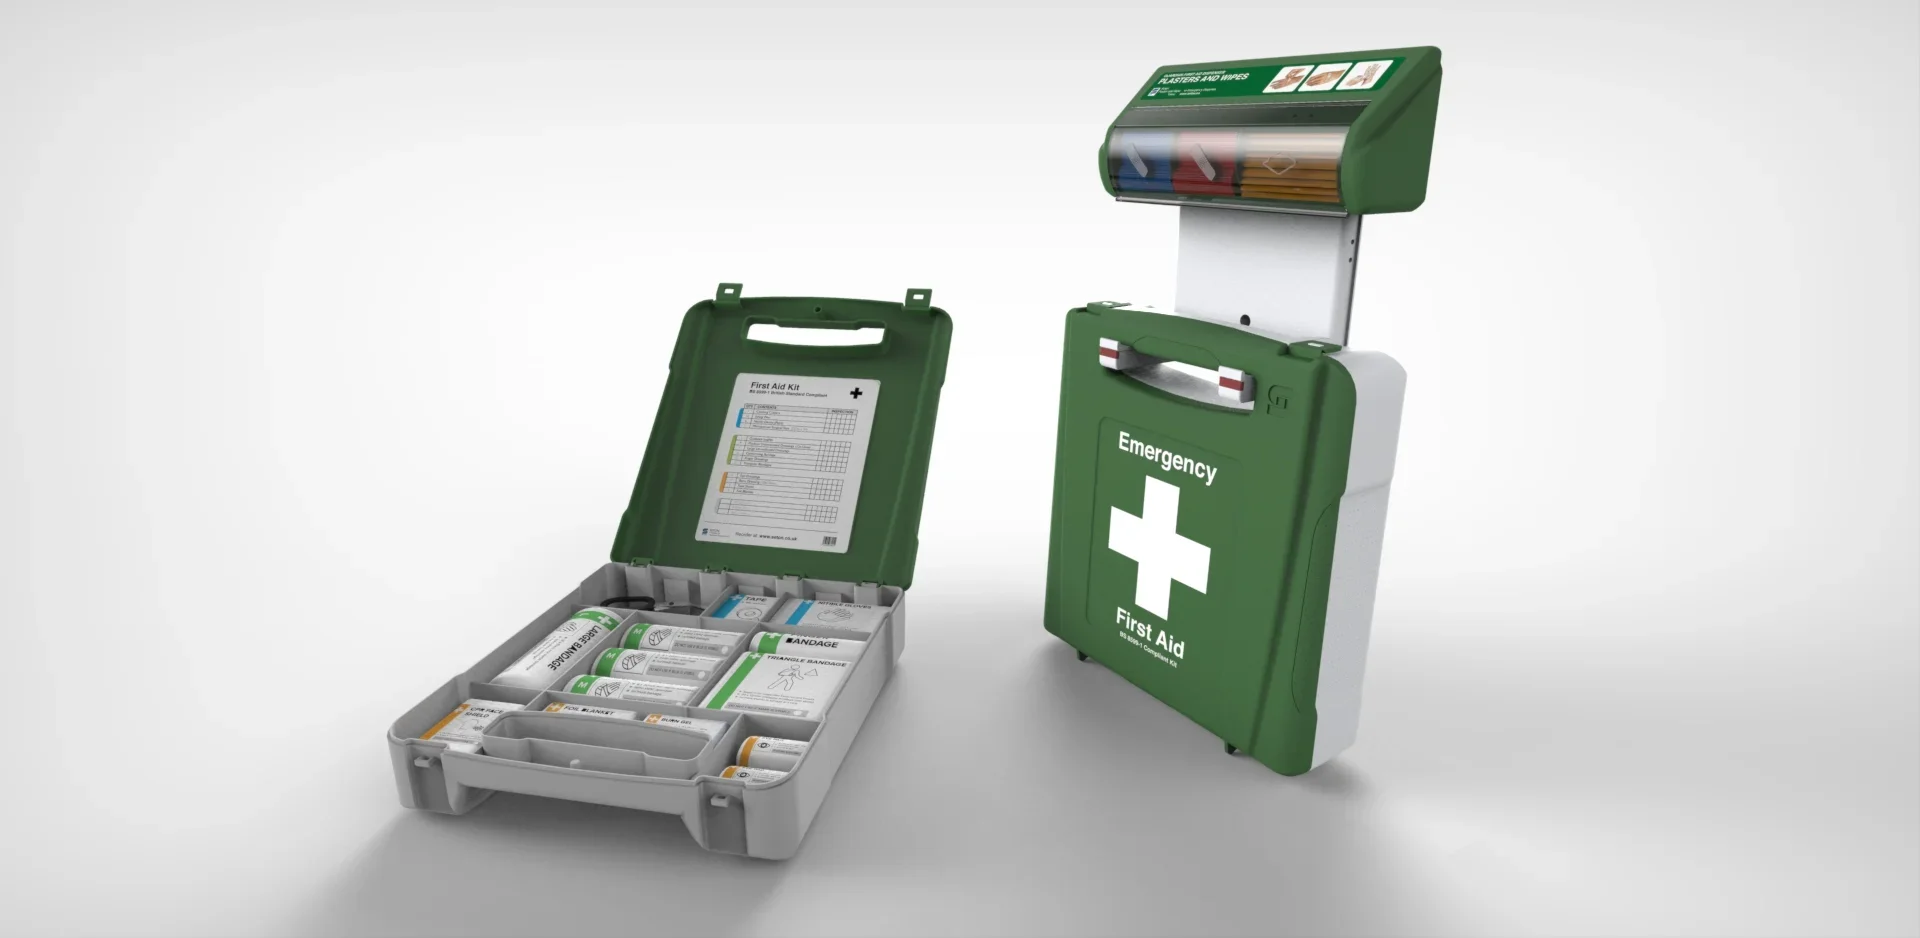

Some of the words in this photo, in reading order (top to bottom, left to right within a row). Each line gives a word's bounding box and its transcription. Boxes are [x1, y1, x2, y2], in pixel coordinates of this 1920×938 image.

[1158, 76, 1201, 84] PLASTERS
[1200, 74, 1220, 82] AND
[1220, 73, 1250, 81] WIPES
[750, 382, 770, 390] First
[771, 382, 786, 390] Aid
[787, 383, 800, 391] Kit
[1118, 431, 1217, 486] Emergency
[577, 625, 602, 645] LARGE
[1116, 606, 1152, 641] First
[1155, 630, 1185, 659] Aid
[547, 641, 583, 671] BANDAGE
[766, 655, 806, 664] TRIANGLE
[806, 659, 847, 668] BANDAGE
[1119, 630, 1127, 640] BS
[1143, 644, 1169, 663] Compliant
[1169, 658, 1178, 668] Kit
